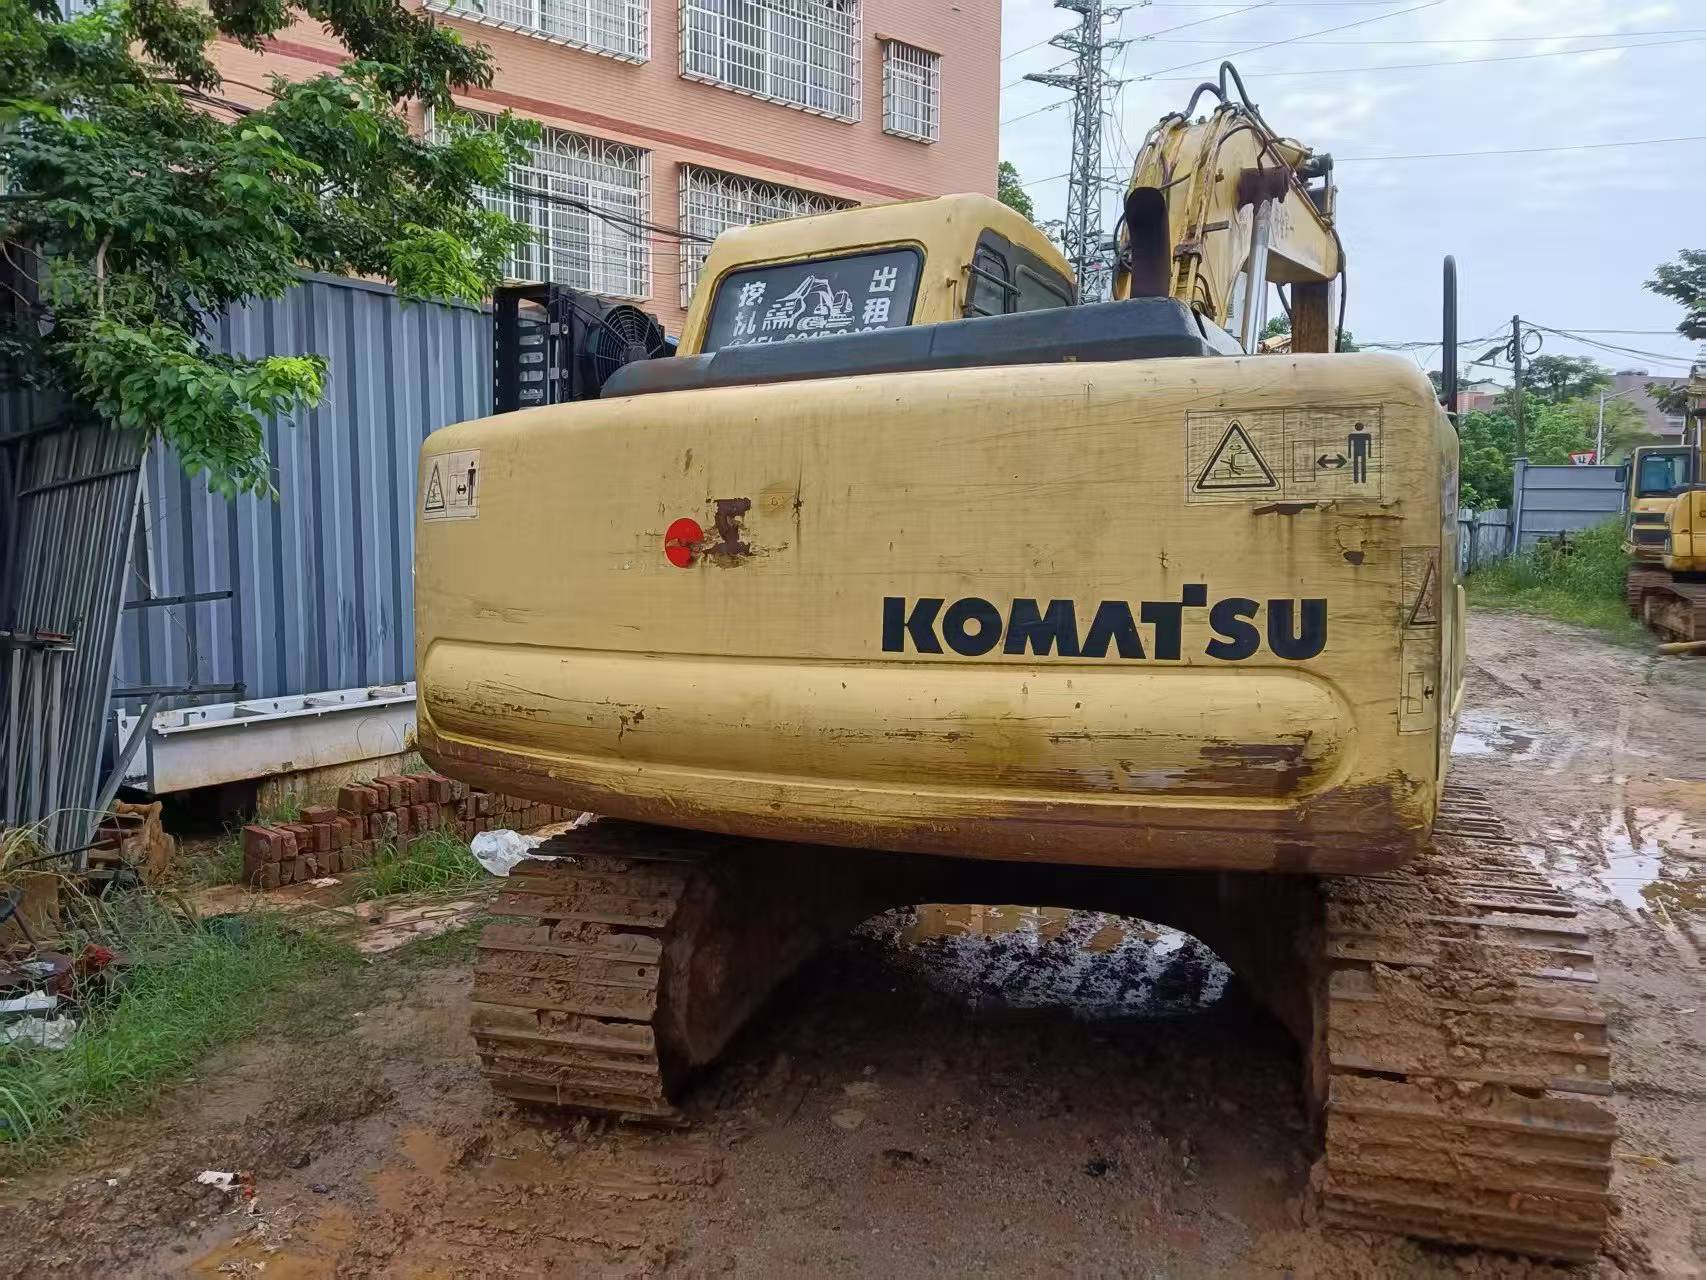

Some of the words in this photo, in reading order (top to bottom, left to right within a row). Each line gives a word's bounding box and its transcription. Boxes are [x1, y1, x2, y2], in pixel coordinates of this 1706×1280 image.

[732, 280, 767, 337] 挖机
[862, 265, 898, 325] 出租
[882, 583, 1328, 661] KOMATSU
